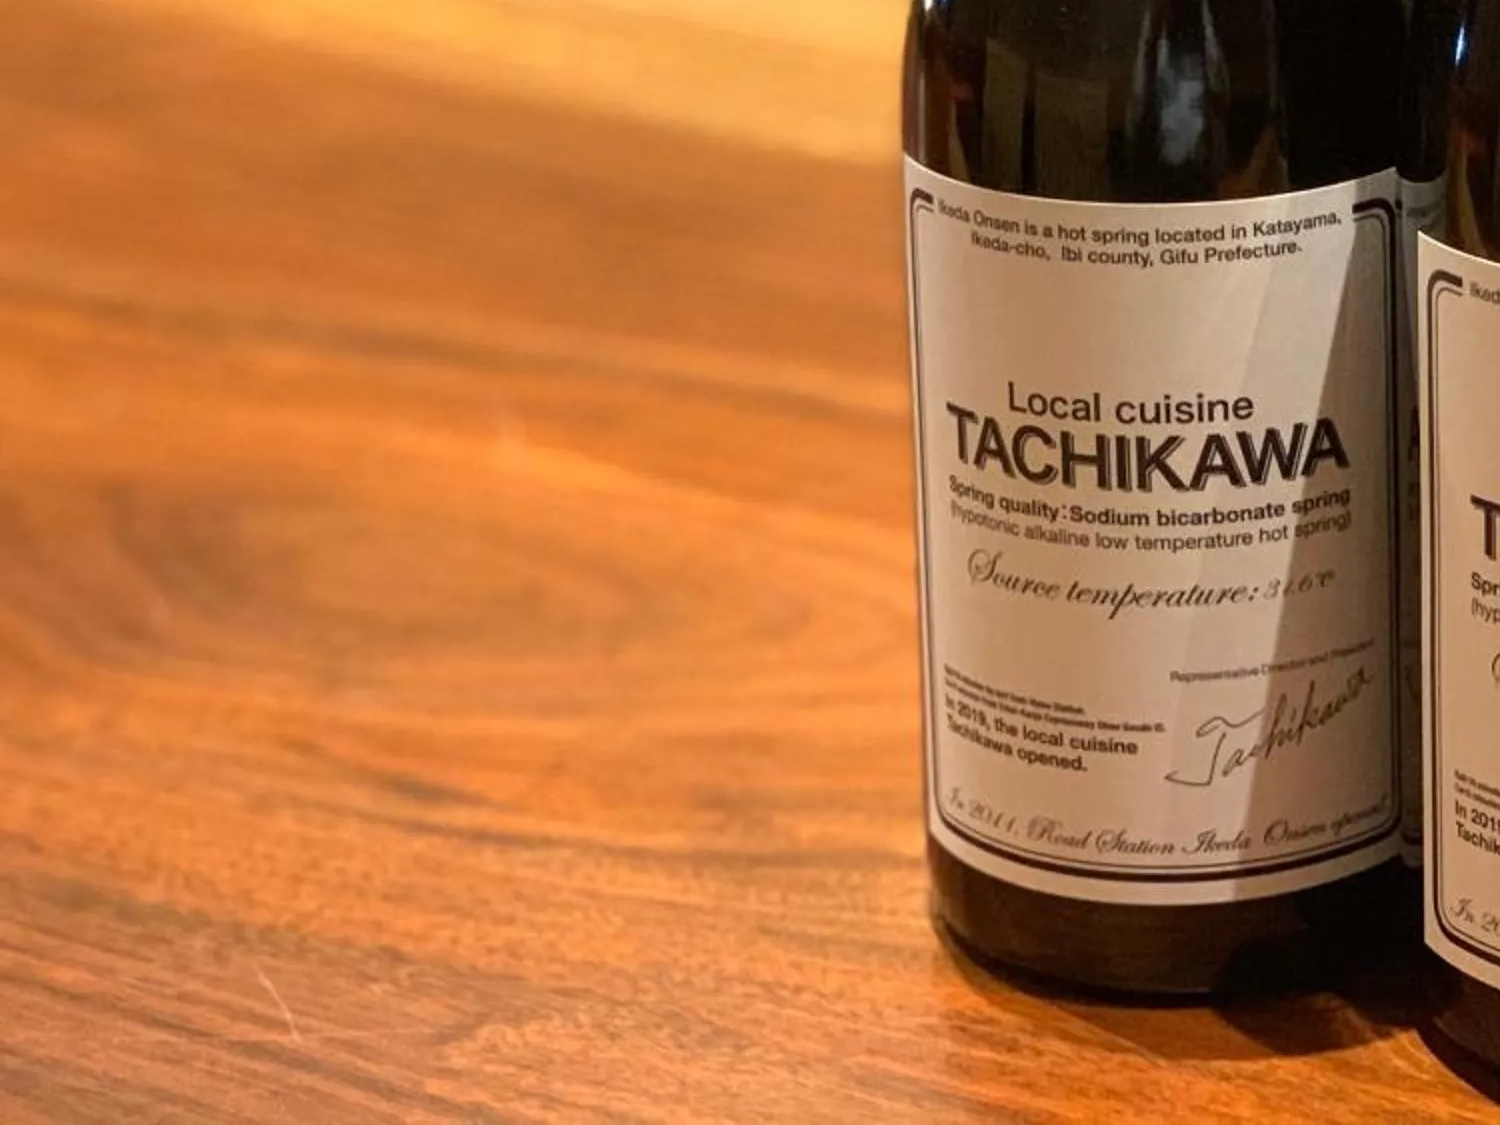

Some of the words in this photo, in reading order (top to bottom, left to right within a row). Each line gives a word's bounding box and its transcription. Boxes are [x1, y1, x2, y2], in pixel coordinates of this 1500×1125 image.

[973, 210, 1020, 233] Onsen
[1025, 220, 1038, 236] is
[1043, 226, 1053, 237] a
[1058, 224, 1086, 241] hot
[1092, 229, 1149, 247] spring
[1155, 225, 1225, 243] located
[1232, 224, 1247, 239] in
[1253, 212, 1342, 235] Katayama,
[1061, 247, 1082, 261] Ibi
[1088, 249, 1153, 267] county,
[1161, 249, 1198, 264] Gifu
[1205, 242, 1302, 263] Prefecture.
[1007, 381, 1101, 421] Local
[1115, 394, 1254, 423] cuisine
[946, 402, 1351, 492] TACHIKAWA
[949, 475, 994, 510] Spring
[1157, 502, 1285, 526] bicarbonate
[1292, 489, 1351, 514] spring
[1024, 526, 1090, 547] alkaline
[1096, 531, 1128, 549] low
[1135, 531, 1253, 553] temperature
[1259, 526, 1289, 543] hot
[968, 548, 1060, 600] Source
[994, 717, 1019, 737] the
[1023, 724, 1064, 747] local
[1069, 735, 1138, 755] cuisine
[1016, 746, 1088, 772] opened.
[1454, 799, 1467, 819] In
[1096, 828, 1175, 855] Station
[1451, 897, 1475, 924] In
